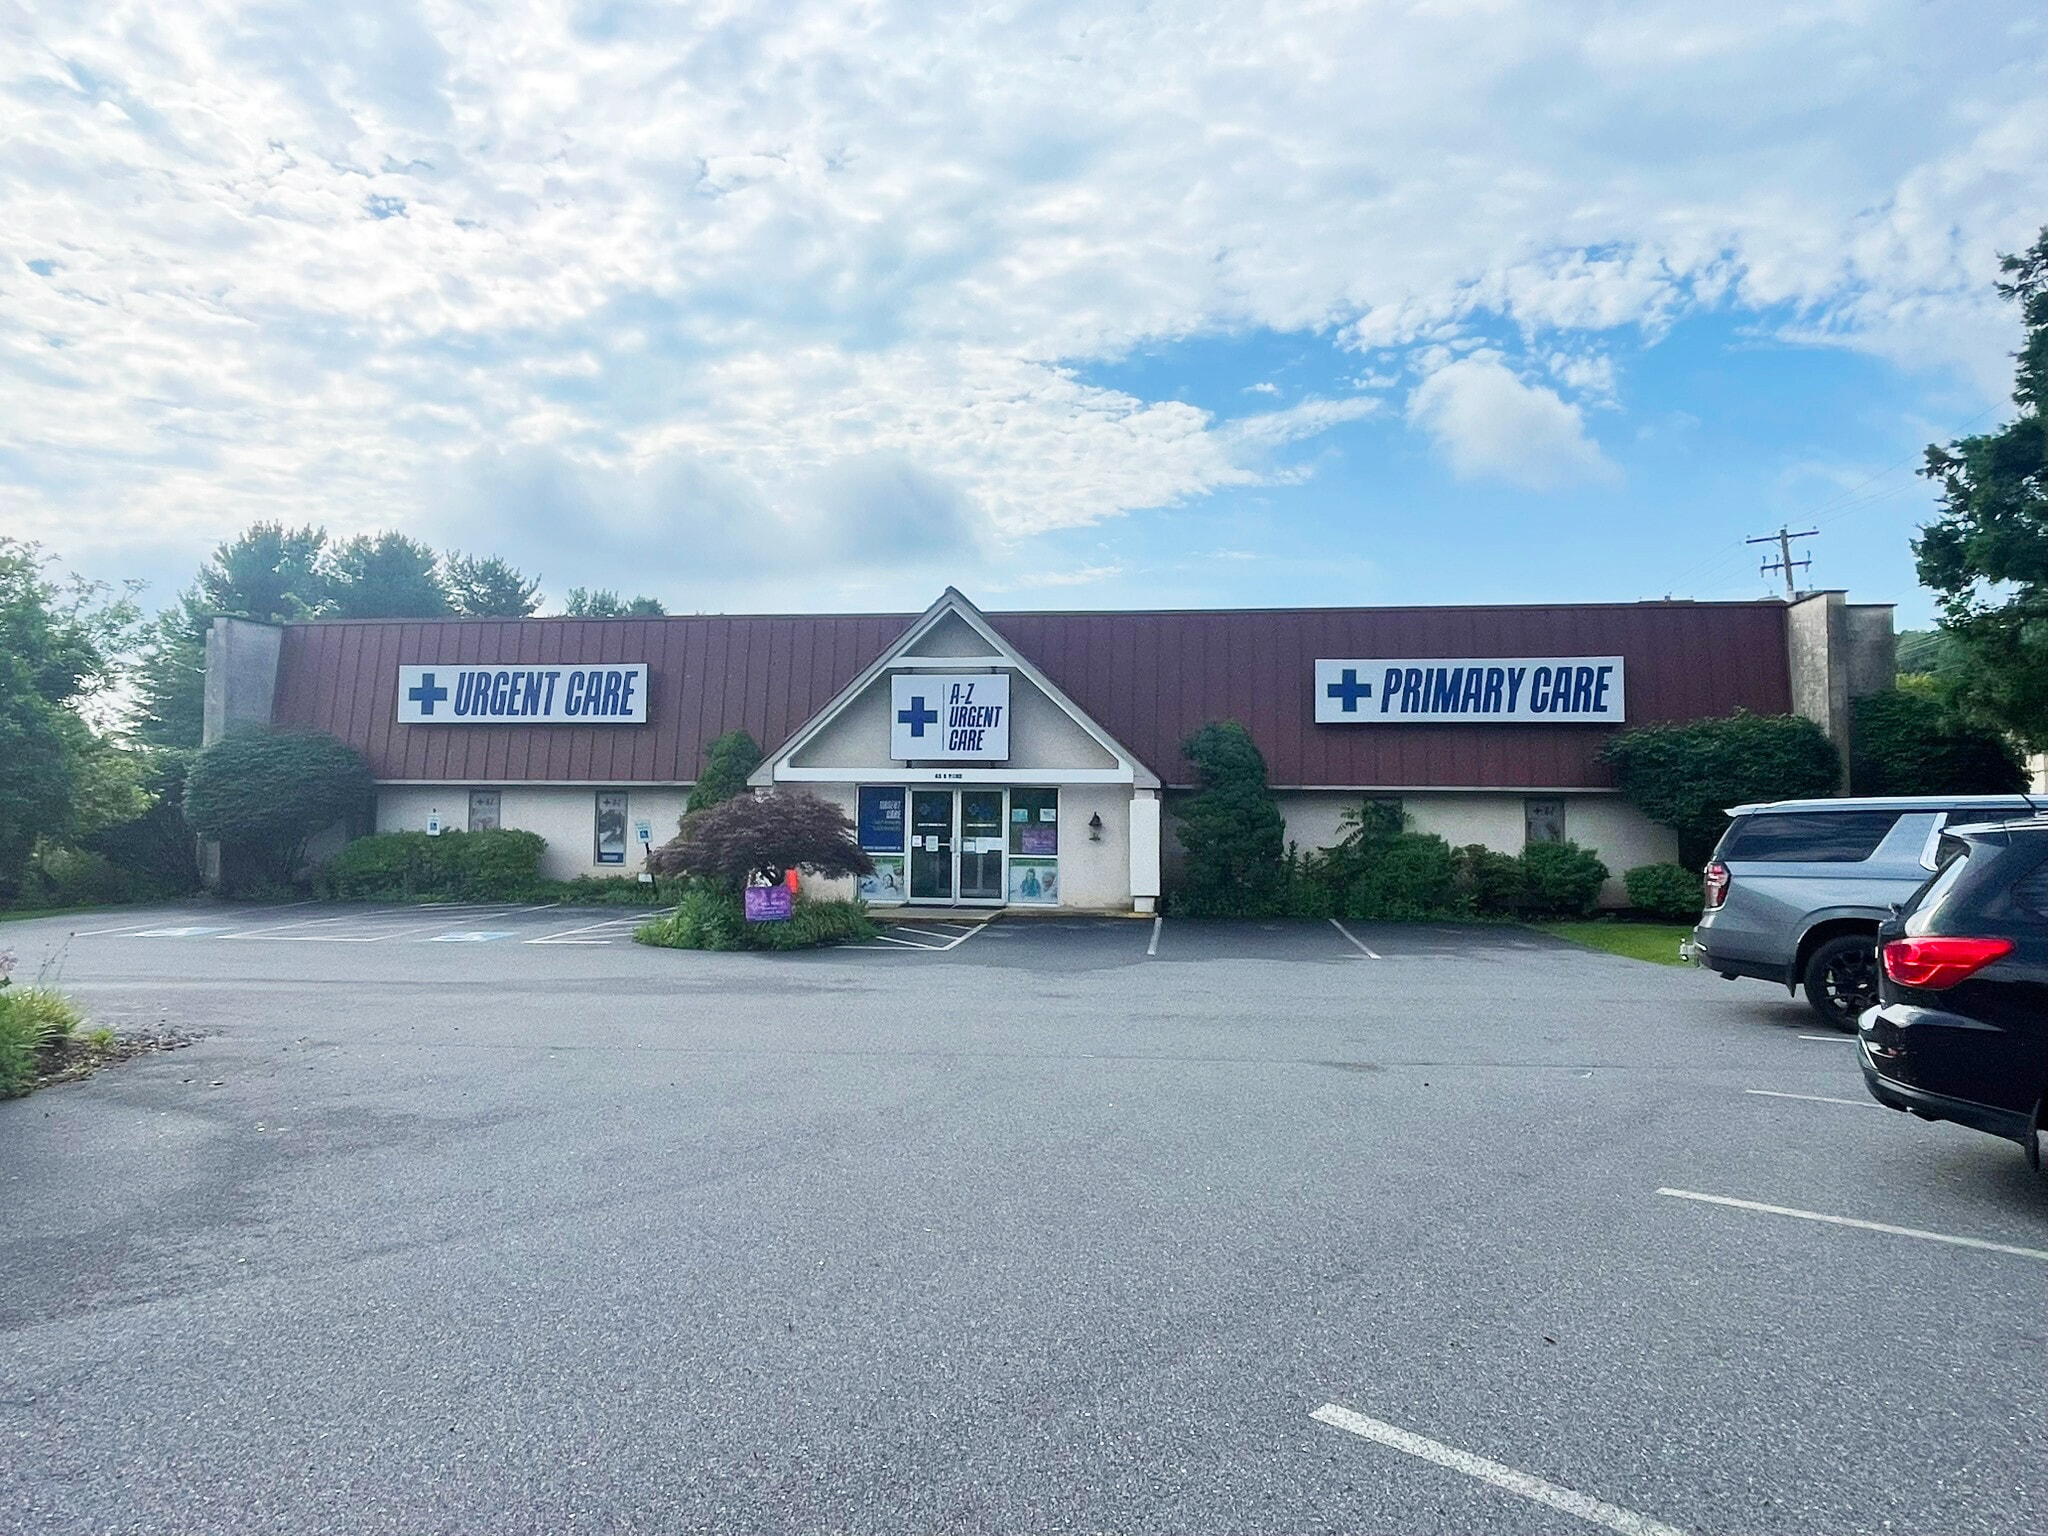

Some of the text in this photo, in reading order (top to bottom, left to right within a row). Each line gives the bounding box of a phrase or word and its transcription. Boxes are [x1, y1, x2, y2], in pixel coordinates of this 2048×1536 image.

[454, 671, 639, 716] URGENT CARE
[949, 683, 975, 705] A-Z
[1380, 666, 1613, 713] PRIMARY CARE
[949, 706, 1003, 728] URGENT
[948, 729, 985, 751] CARE
